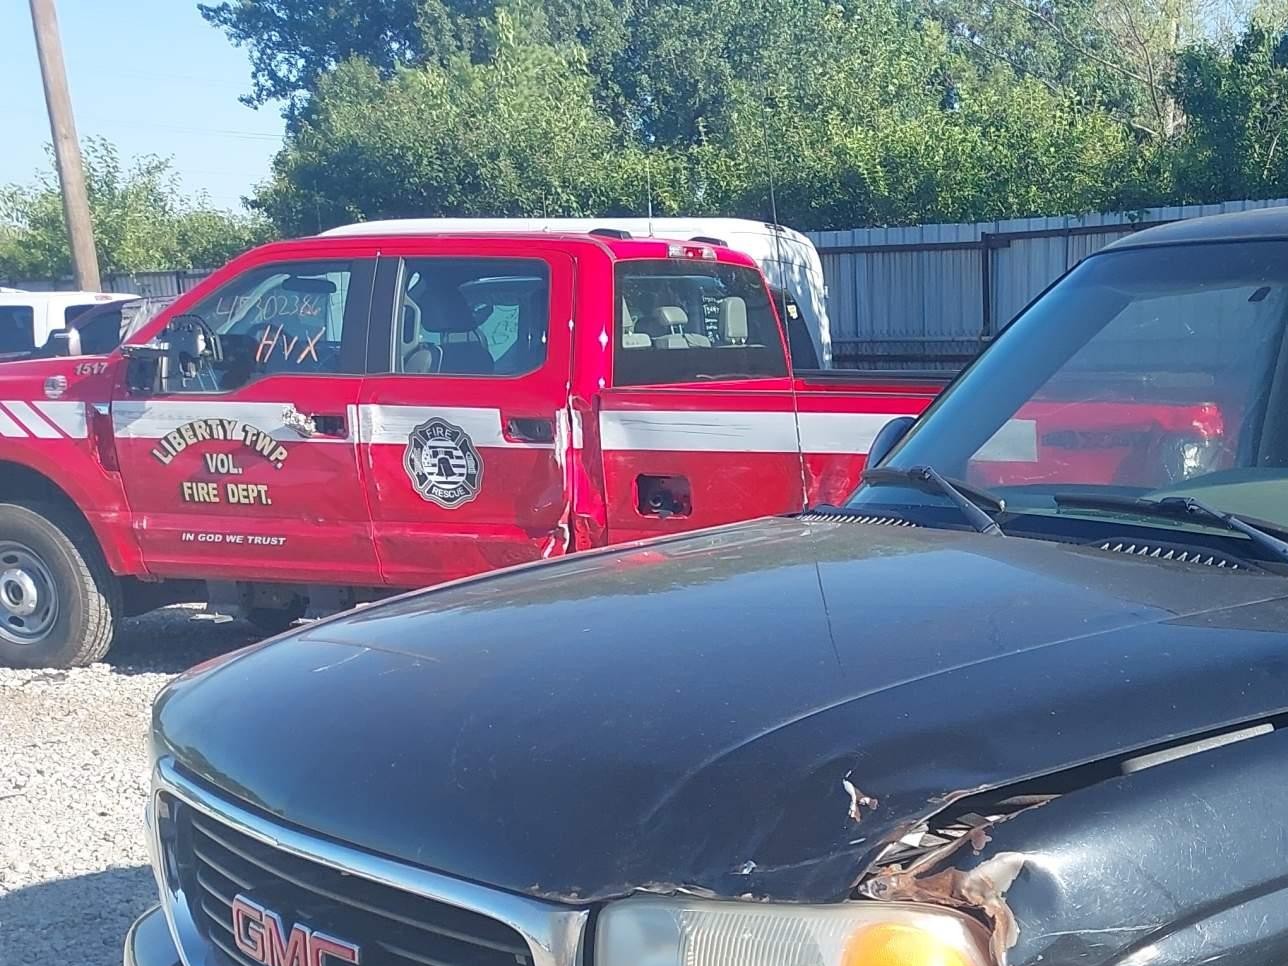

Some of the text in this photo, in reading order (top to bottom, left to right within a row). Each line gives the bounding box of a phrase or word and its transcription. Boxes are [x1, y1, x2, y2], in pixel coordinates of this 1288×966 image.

[74, 362, 109, 377] 1517
[425, 426, 452, 441] FIRE
[151, 417, 289, 470] LIBERTY TWP.
[205, 452, 243, 475] VOL.
[182, 482, 273, 505] FIRE DEPT.
[431, 486, 466, 498] RESCUE
[182, 532, 286, 546] IN GOD WE TRUST
